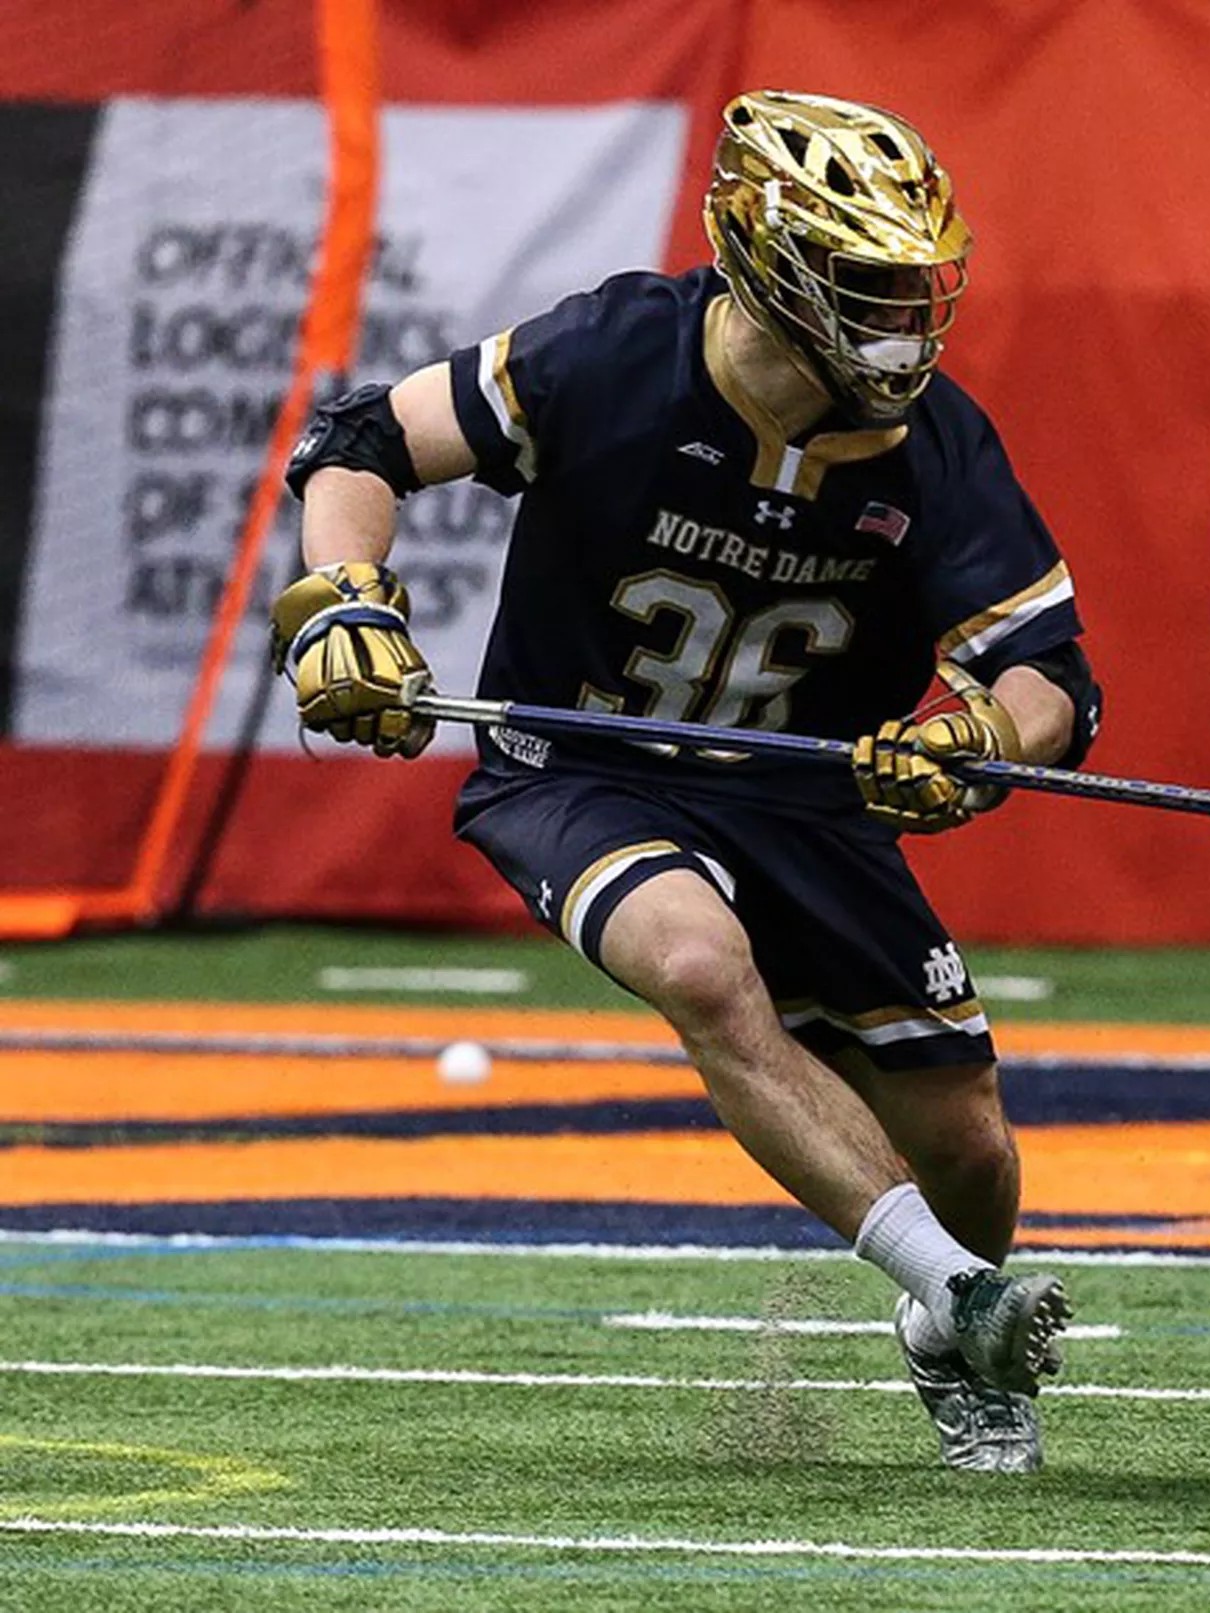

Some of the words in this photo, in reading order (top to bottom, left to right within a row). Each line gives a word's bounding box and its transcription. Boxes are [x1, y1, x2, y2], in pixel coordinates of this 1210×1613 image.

[647, 509, 768, 579] NOTRE
[771, 549, 875, 584] DAME
[575, 566, 856, 763] 36
